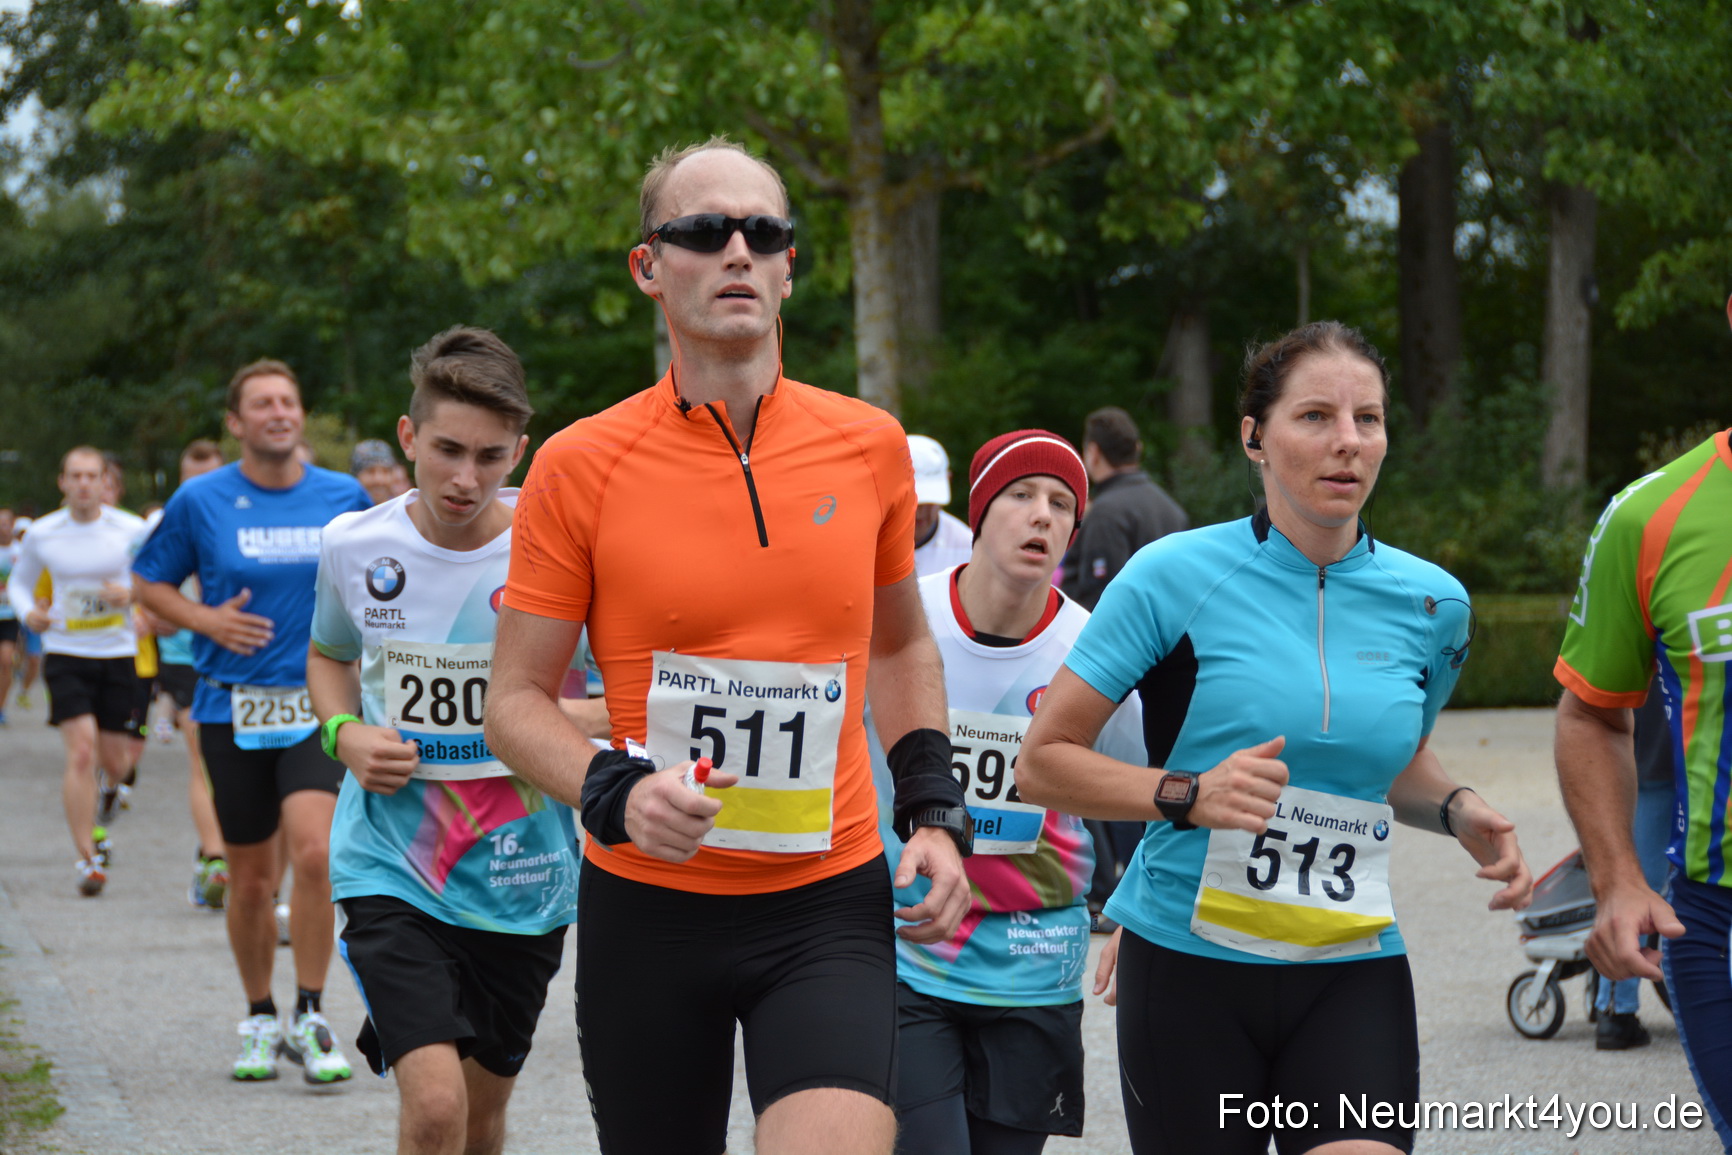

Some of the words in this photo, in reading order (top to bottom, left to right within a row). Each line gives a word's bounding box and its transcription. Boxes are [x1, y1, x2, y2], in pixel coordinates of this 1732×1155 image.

[364, 607, 406, 620] PARTL
[365, 620, 406, 630] Neumarkt
[387, 651, 433, 669] PARTL
[1356, 651, 1390, 662] GORE
[658, 670, 722, 695] PARTL
[728, 680, 819, 700] Neumarkt
[240, 695, 315, 727] 2259
[400, 674, 488, 727] 280
[690, 704, 806, 779] 511
[956, 724, 1024, 744] Neumark
[1291, 806, 1368, 836] Neumarkt
[489, 833, 525, 856] 16.
[1246, 828, 1357, 903] 513
[489, 867, 552, 888] Stadtlauf
[1007, 925, 1079, 939] Neumarkter
[1009, 940, 1069, 956] Stadtlauf
